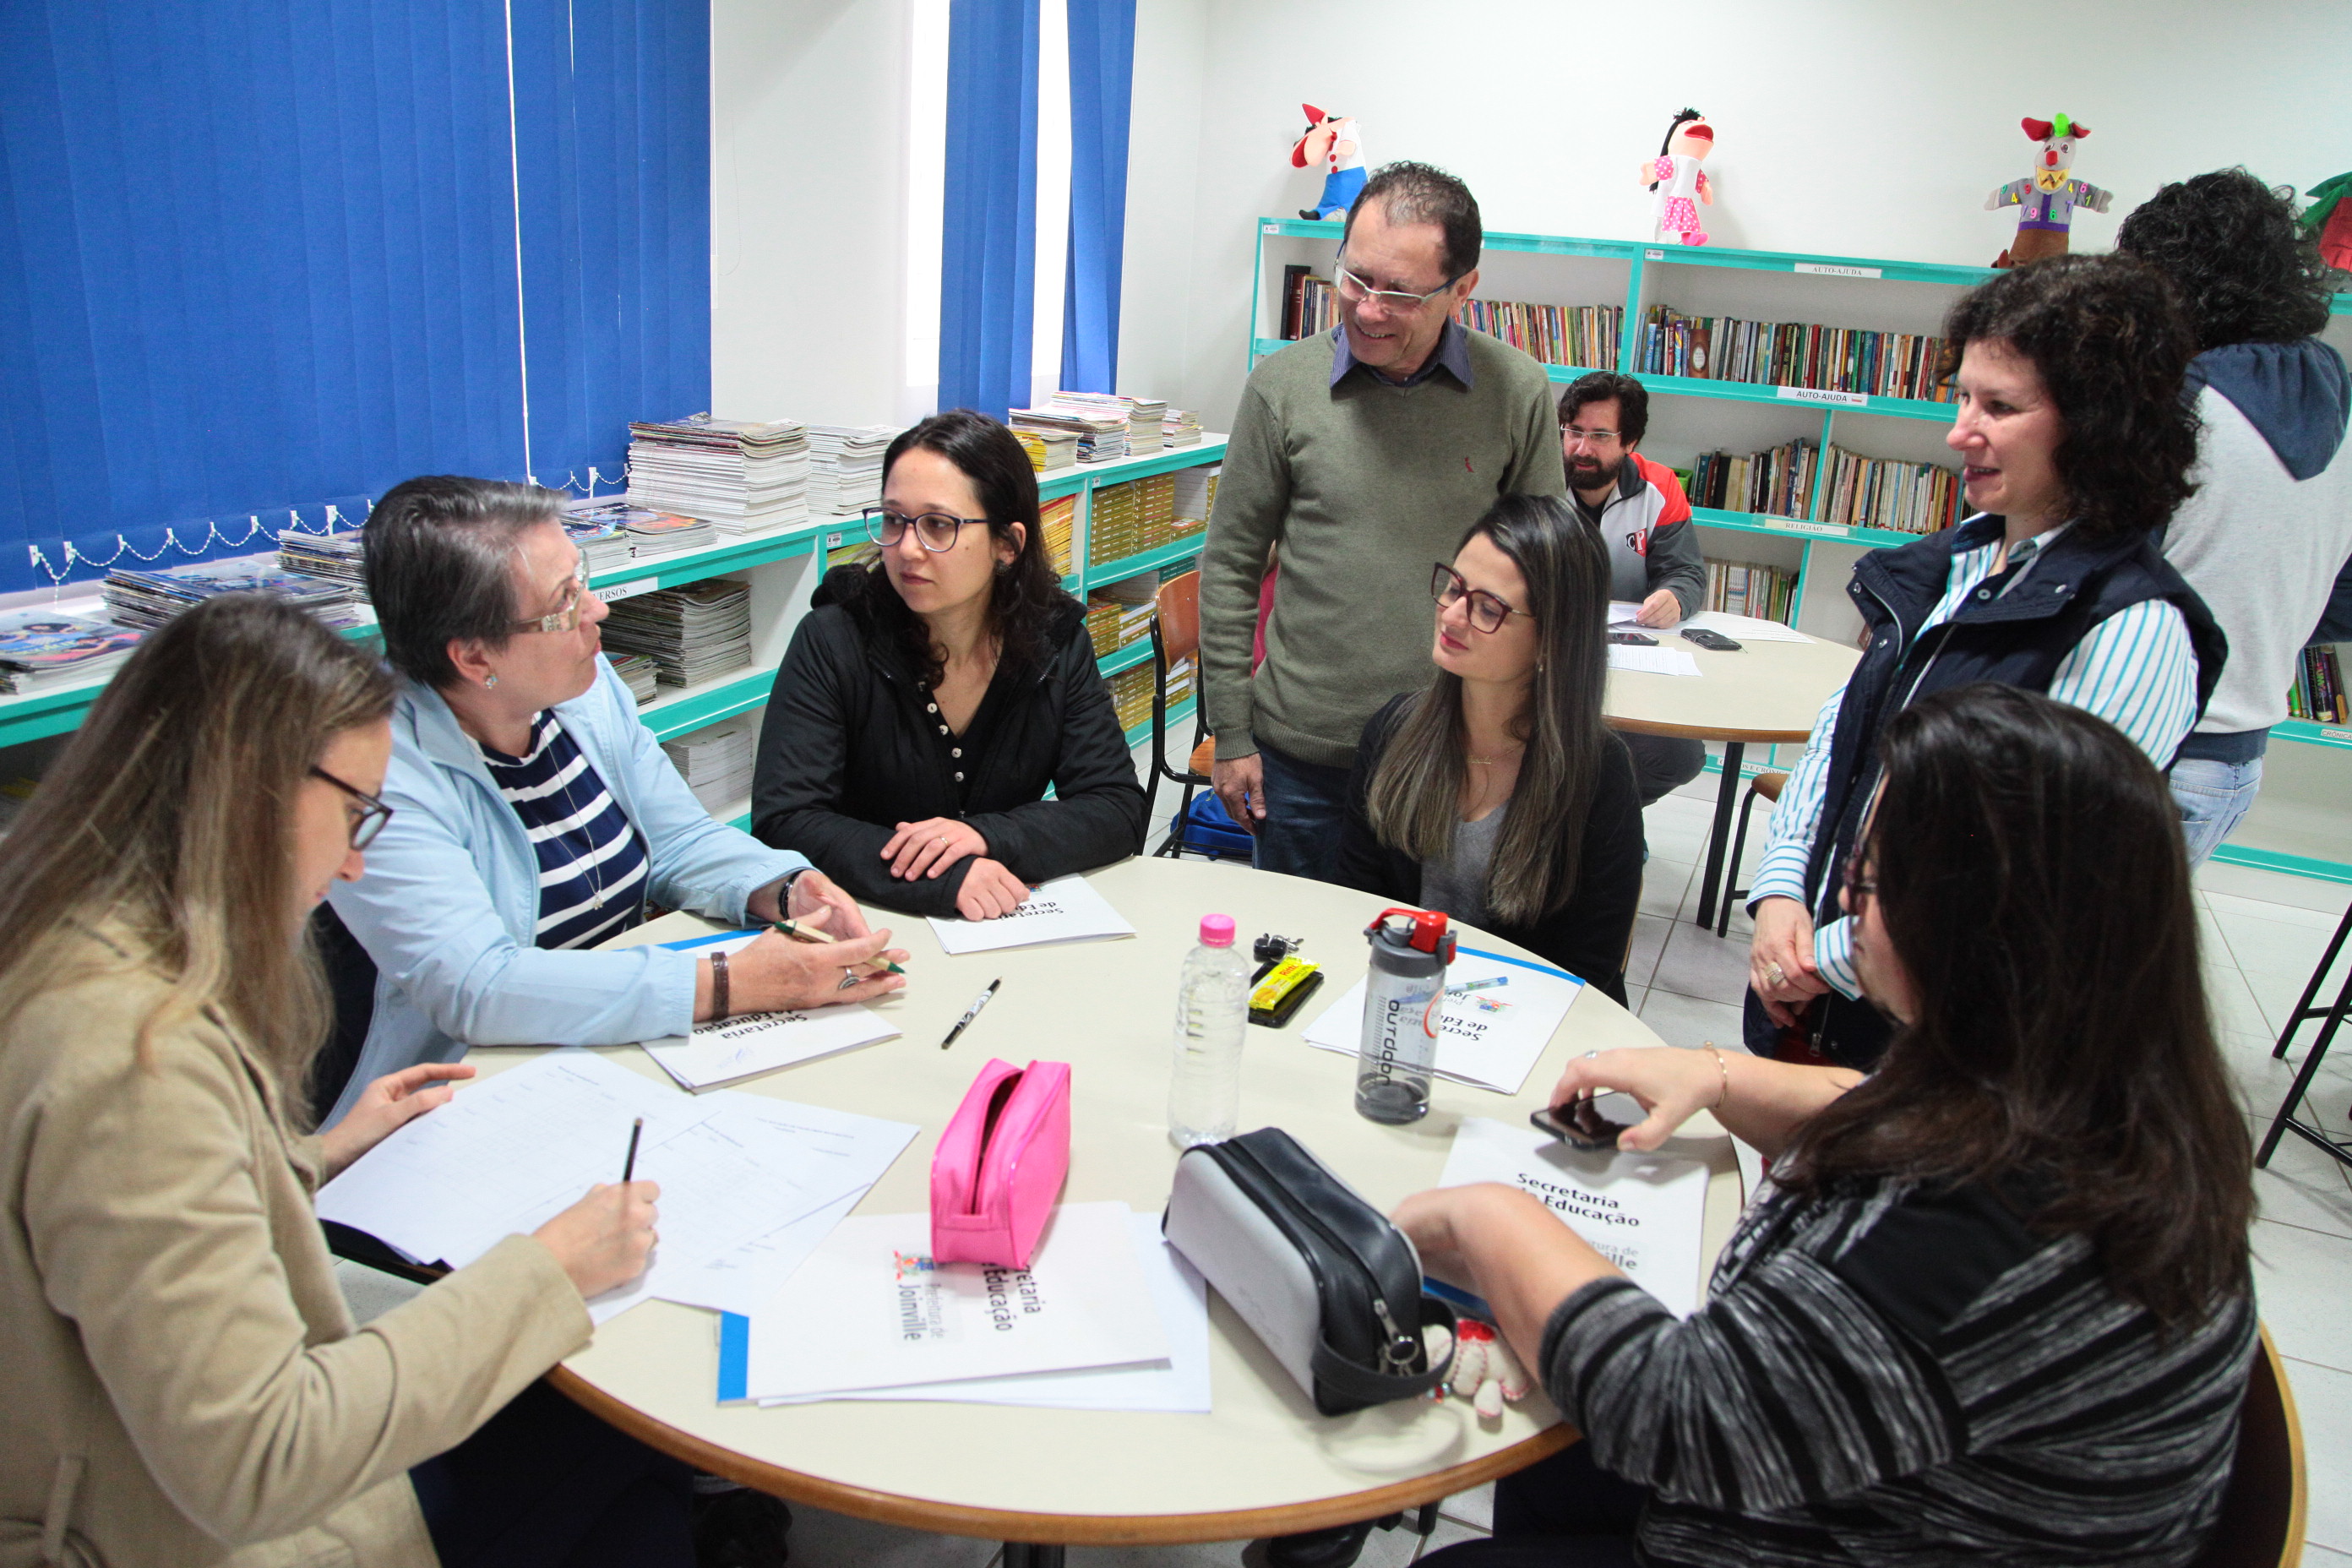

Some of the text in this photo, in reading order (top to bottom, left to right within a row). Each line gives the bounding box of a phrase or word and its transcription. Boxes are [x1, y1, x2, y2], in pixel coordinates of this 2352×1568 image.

[1812, 266, 1862, 276] AUTO-AJUDA
[1796, 390, 1848, 402] AUTO-AJUDA
[1785, 522, 1823, 532] RELIGIÃO
[998, 907, 1064, 920] Secretari
[721, 1014, 808, 1039] Secretaria
[1467, 1021, 1488, 1032] de
[1516, 1173, 1620, 1209] Secretaria
[1544, 1194, 1640, 1227] Educação
[983, 1268, 1018, 1331] Educação
[1015, 1265, 1047, 1314] retaria
[898, 1283, 928, 1341] Joinville
